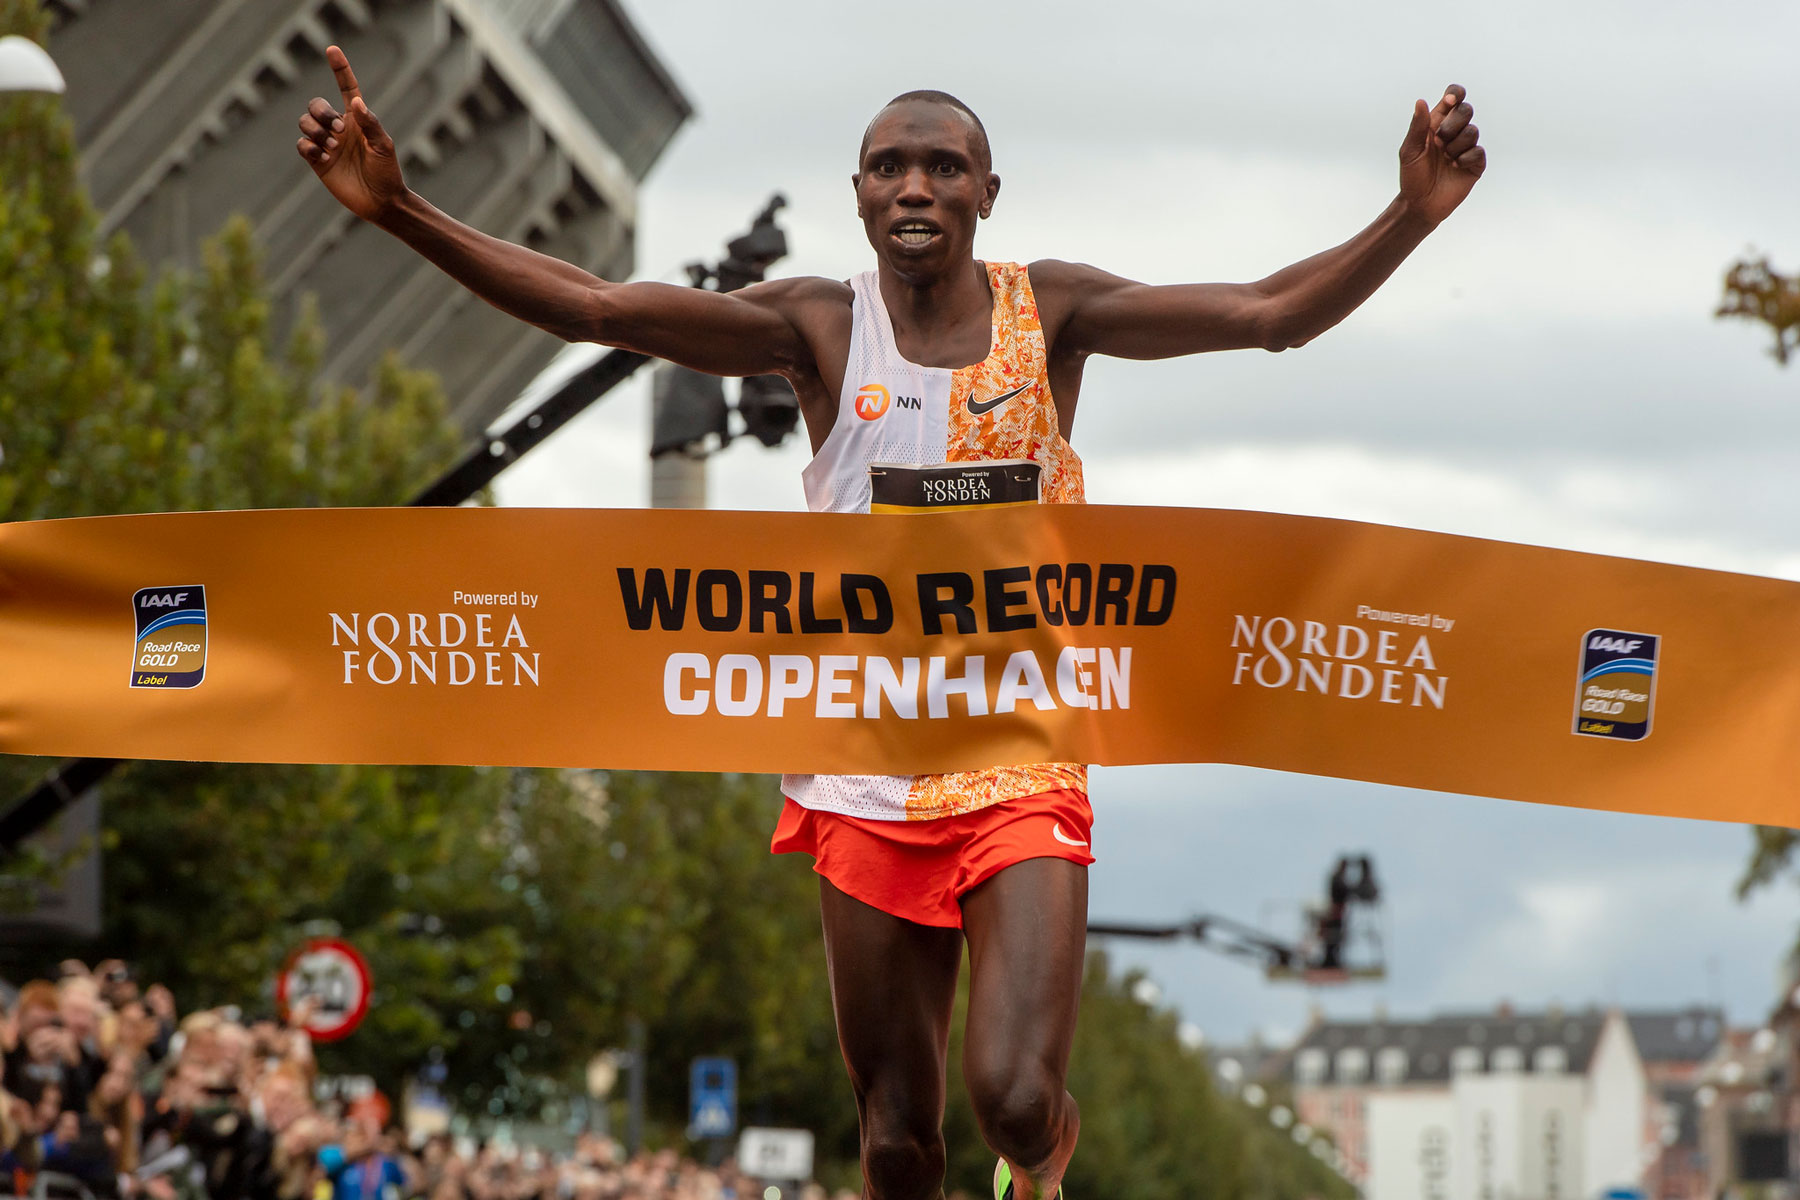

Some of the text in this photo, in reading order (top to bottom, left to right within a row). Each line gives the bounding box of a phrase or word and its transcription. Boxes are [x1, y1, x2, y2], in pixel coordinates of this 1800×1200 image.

[896, 396, 922, 411] NN
[922, 479, 987, 491] NORDEA
[926, 488, 991, 502] FONDEN
[140, 592, 189, 608] IAAF
[453, 591, 538, 609] Powered by
[616, 562, 1177, 635] WORLD RECORD
[1356, 605, 1455, 632] Powered by
[329, 612, 530, 648] NORDEA
[143, 641, 201, 653] Road Race
[1230, 615, 1437, 670] NORDEA
[1588, 635, 1644, 654] IAAF
[140, 654, 178, 666] GOLD
[342, 648, 541, 687] FONDEN
[137, 674, 168, 686] Label
[663, 646, 1133, 720] COPENHAGEN
[1232, 648, 1449, 709] FONDEN
[1585, 685, 1648, 702] Road Race
[1581, 698, 1625, 714] GOLD
[1579, 721, 1614, 734] Label
